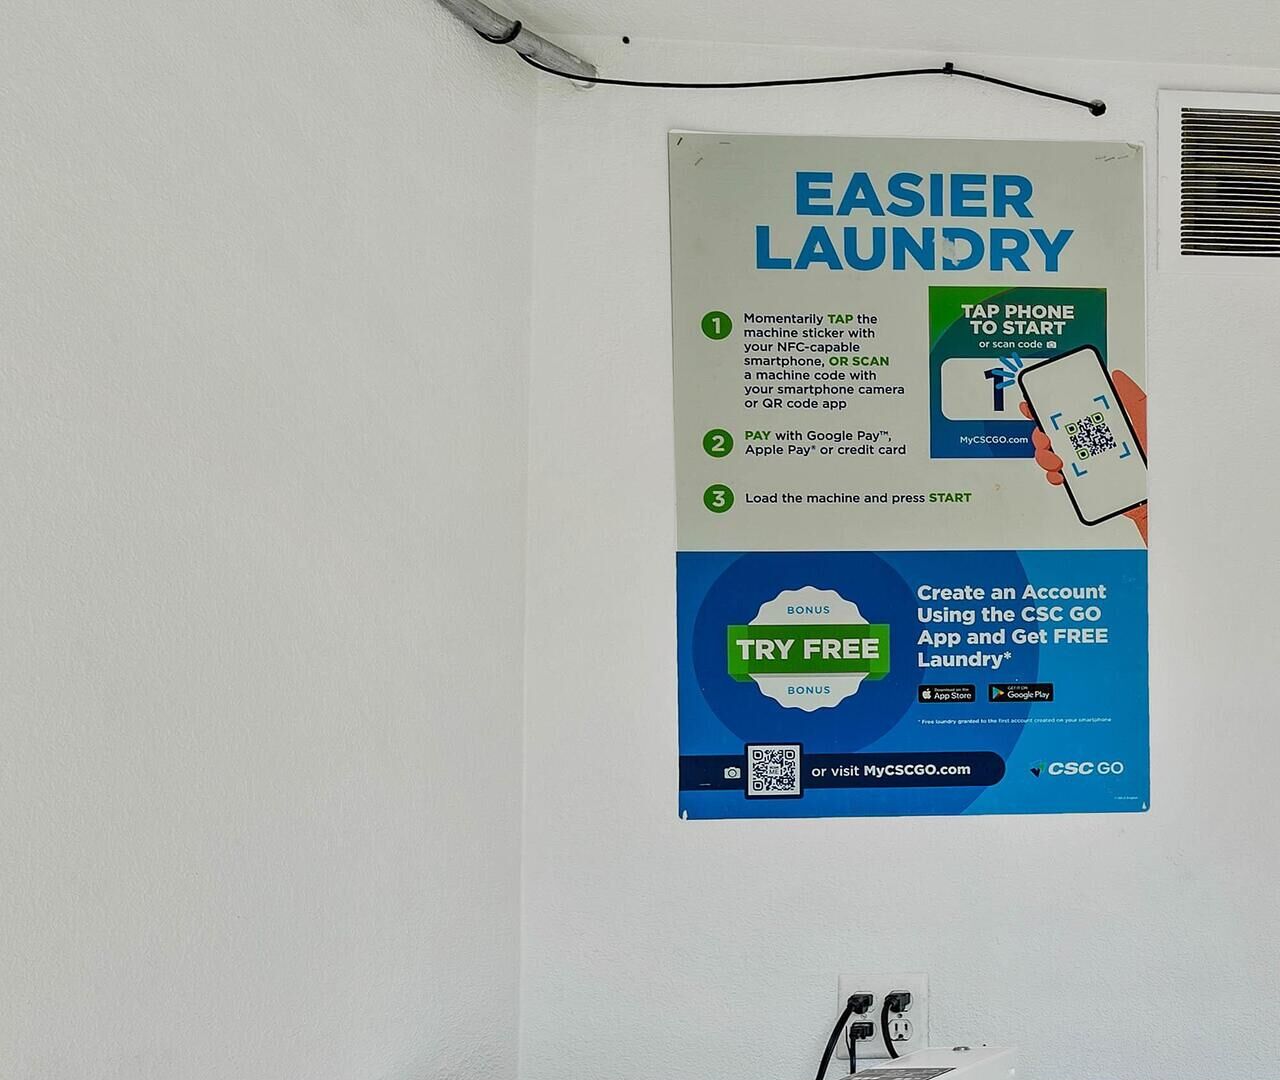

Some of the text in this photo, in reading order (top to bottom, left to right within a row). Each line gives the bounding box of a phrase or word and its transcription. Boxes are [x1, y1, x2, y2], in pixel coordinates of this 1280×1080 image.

[795, 171, 1034, 218] EASIER
[756, 225, 1074, 272] LAUNDRY
[962, 304, 1074, 318] TAP PHONE
[744, 313, 878, 325] Momentarily TAP the
[711, 317, 723, 334] 1
[970, 321, 1066, 334] TO START
[744, 328, 874, 338] machine sticker with
[744, 342, 860, 354] your NFC-capable
[1018, 340, 1042, 348] code
[744, 356, 889, 368] smartphone, OR SCAN
[756, 370, 810, 380] machine
[813, 370, 846, 381] code
[849, 370, 876, 380] with
[744, 384, 904, 396] your smartphone camera
[745, 398, 846, 410] or QR code app
[745, 431, 771, 440] PAY
[776, 430, 802, 440] with
[807, 431, 852, 443] Google
[960, 435, 1028, 446] MyCSCGO.com
[711, 436, 725, 450] 2
[745, 445, 783, 456] Apple
[837, 445, 874, 454] credit
[879, 444, 906, 455] card
[712, 491, 725, 506] 3
[746, 493, 972, 504] Load the machine and press START
[918, 585, 1106, 600] Create an Account
[788, 606, 829, 615] BONUS
[917, 606, 1101, 623] Using the CSC GO
[917, 628, 1108, 646] App and Get FREE
[736, 638, 879, 659] TRY FREE
[788, 686, 830, 694] BONUS
[934, 692, 971, 700] App Store
[1007, 691, 1050, 699] Google Play
[811, 763, 971, 778] or visit MyCSCGO.com
[1048, 761, 1124, 775] CSC GO
